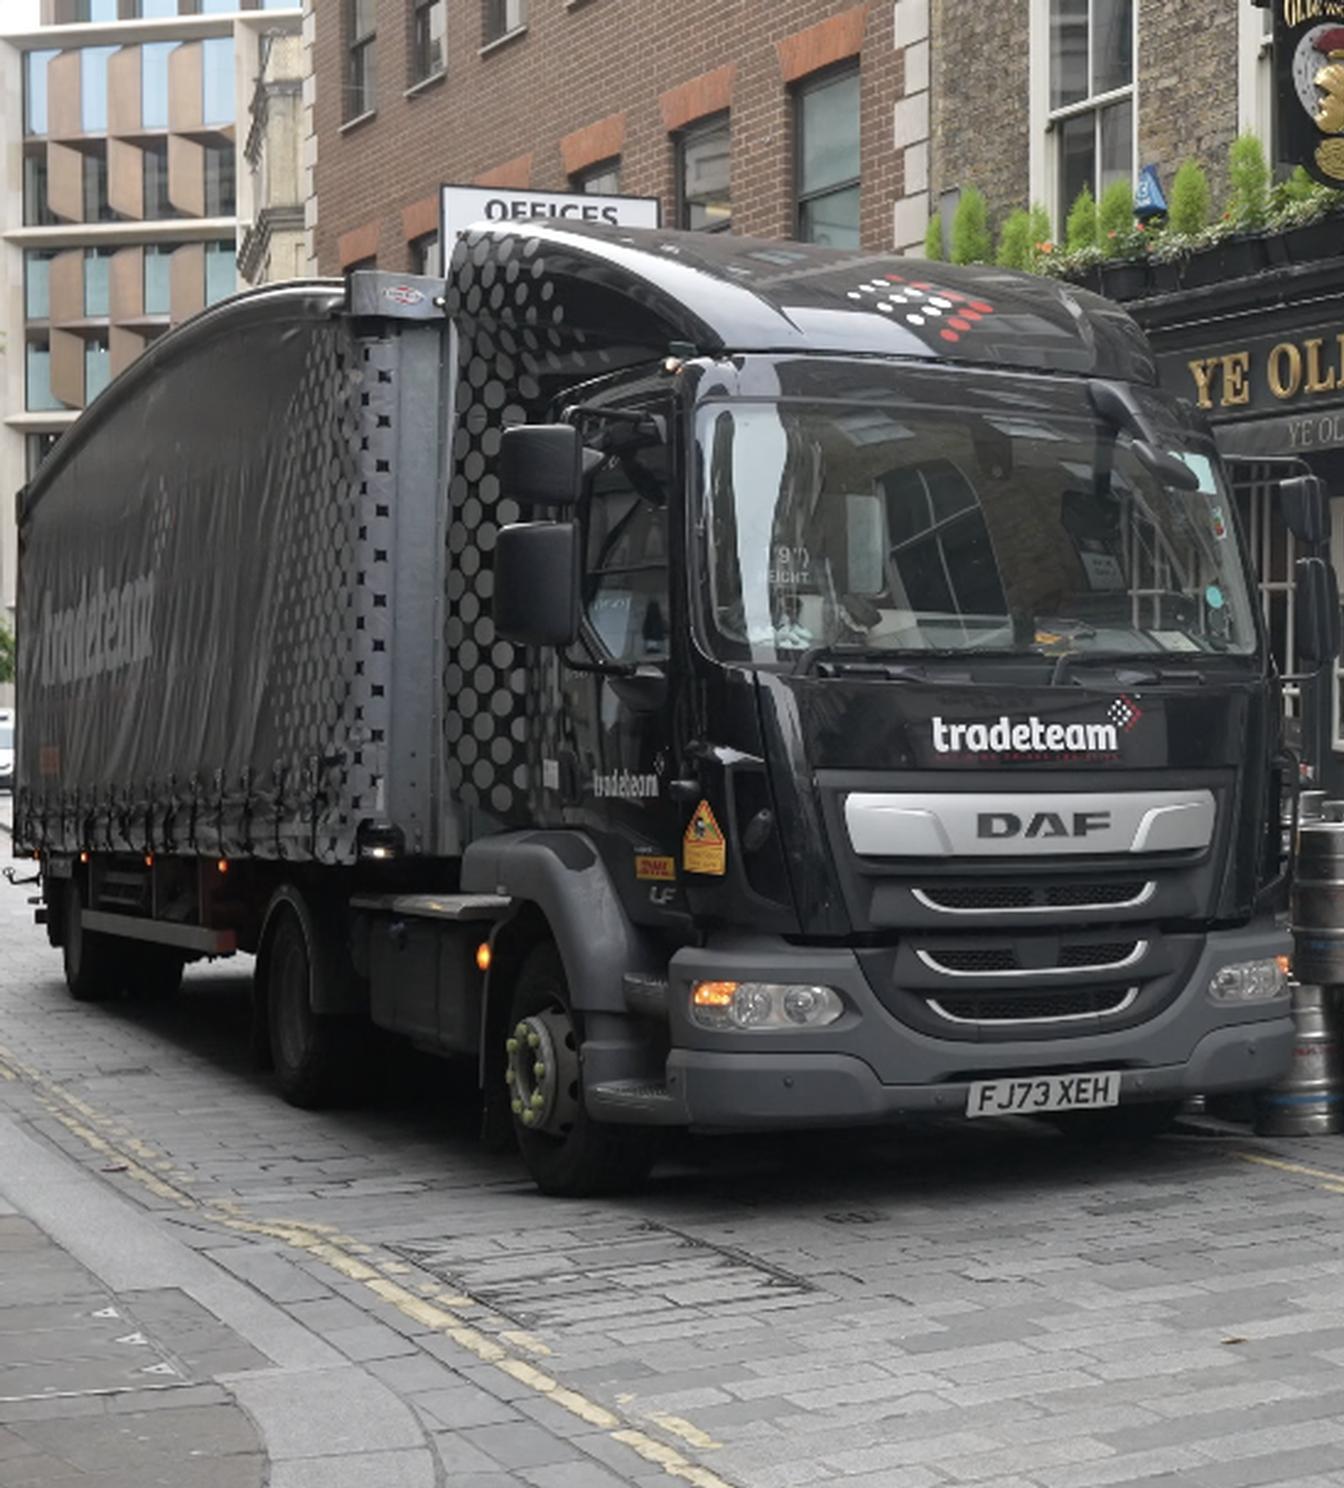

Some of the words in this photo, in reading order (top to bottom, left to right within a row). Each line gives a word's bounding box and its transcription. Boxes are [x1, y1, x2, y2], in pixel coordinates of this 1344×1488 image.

[1188, 351, 1250, 409] YE
[1288, 419, 1313, 447] YE
[762, 570, 810, 584] EIGHT
[931, 716, 1119, 752] tradeteam
[593, 769, 660, 798] tradeteam
[976, 811, 1112, 839] DAF
[978, 1082, 1050, 1111] FJ73
[1056, 1076, 1110, 1106] XEH
